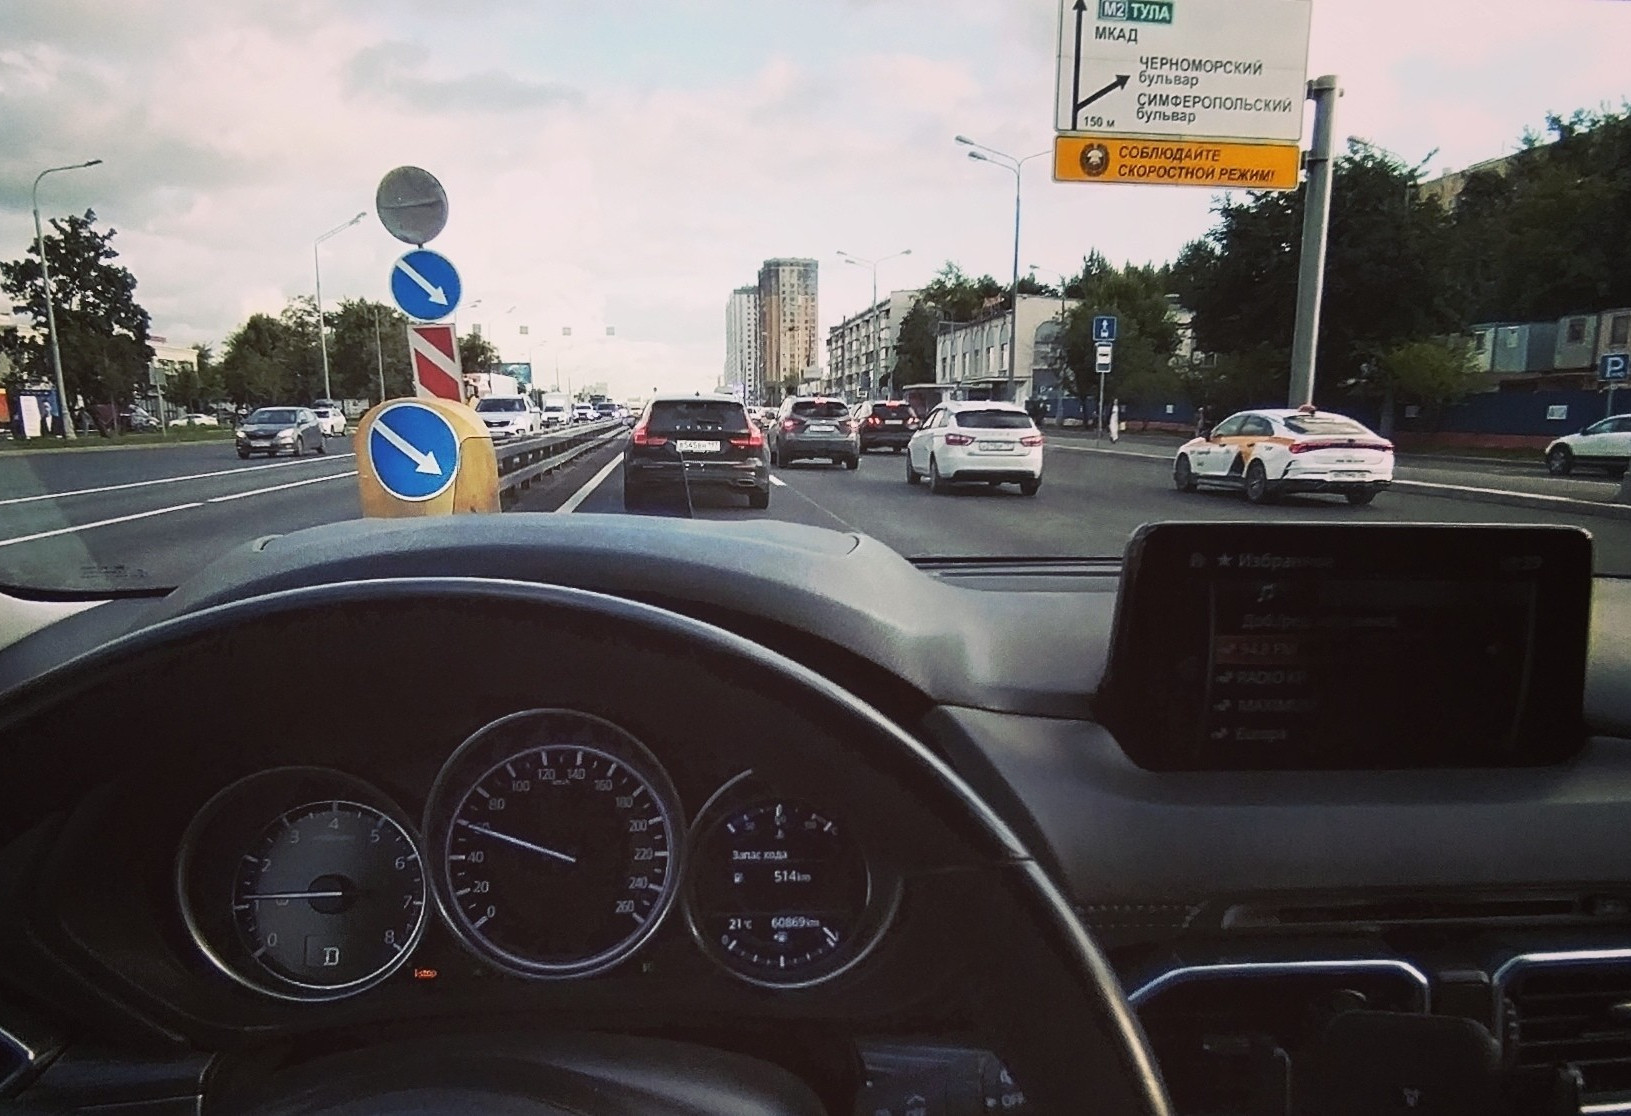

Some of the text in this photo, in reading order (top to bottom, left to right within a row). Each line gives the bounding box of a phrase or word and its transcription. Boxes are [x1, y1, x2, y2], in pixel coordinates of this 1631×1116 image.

[1130, 4, 1171, 21] ТУЛА
[1095, 26, 1138, 44] МКАД
[1139, 55, 1263, 76] ЧЕРНОМОРСКИЙ
[1138, 71, 1199, 88] бульвар
[1137, 92, 1292, 113] СИМФЕРОПОЛЬСКИЙ
[1084, 116, 1103, 128] 150
[1136, 109, 1196, 124] бульвар
[1118, 145, 1221, 163] СОБЛЮДАЙТЕ
[1117, 163, 1275, 183] СКОРОСТНОЙ РЕЖИМ!
[1606, 356, 1624, 378] P
[323, 946, 340, 966] D
